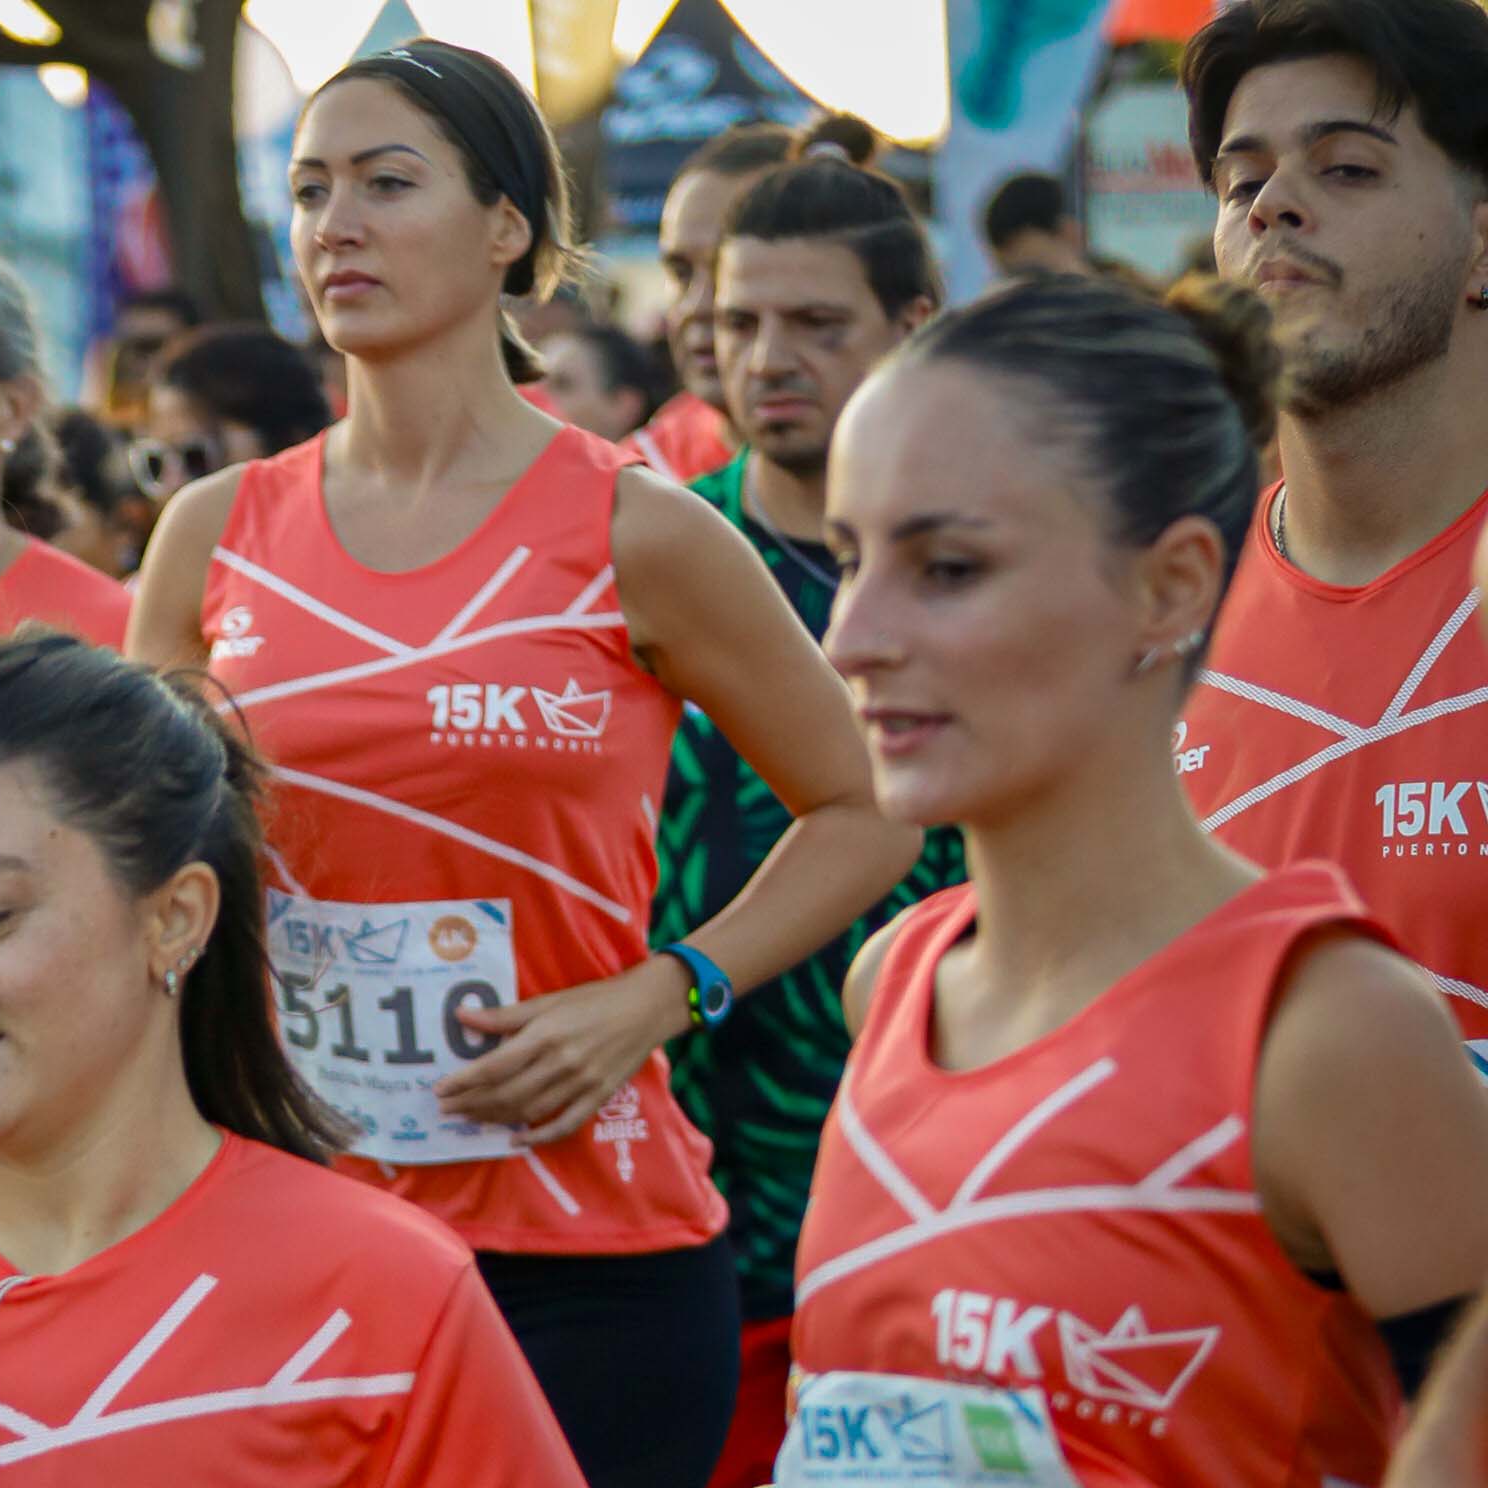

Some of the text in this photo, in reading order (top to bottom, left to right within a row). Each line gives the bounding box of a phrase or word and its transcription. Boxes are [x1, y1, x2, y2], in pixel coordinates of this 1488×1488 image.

[426, 683, 526, 731] 15K
[430, 732, 526, 748] PUERTO
[1375, 781, 1473, 838] 15K
[1382, 843, 1468, 858] PUERTO
[931, 1288, 1054, 1380] 15K
[800, 1403, 882, 1461] 15K
